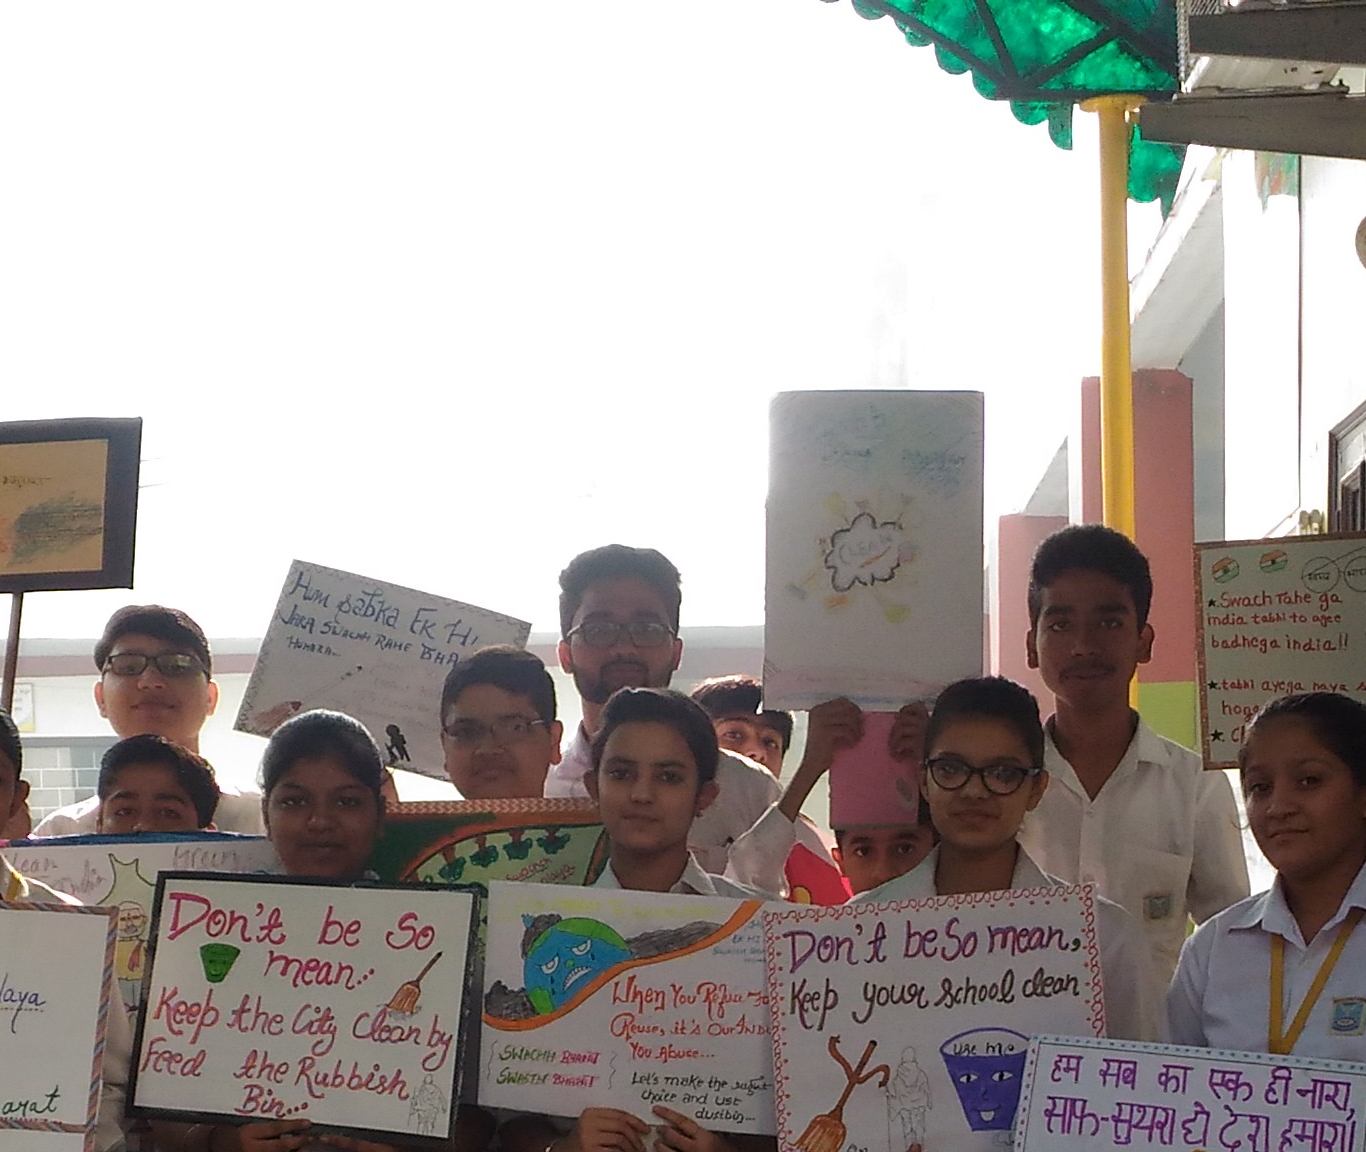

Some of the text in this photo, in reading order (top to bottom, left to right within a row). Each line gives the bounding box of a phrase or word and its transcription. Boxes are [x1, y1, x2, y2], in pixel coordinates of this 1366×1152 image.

[1289, 614, 1307, 623] to
[1319, 592, 1343, 612] ga
[419, 643, 460, 665] BHA
[167, 892, 286, 945] Don't
[318, 905, 362, 947] be
[784, 921, 887, 974] Don't
[904, 920, 937, 958] be
[612, 975, 665, 1014] When
[670, 982, 697, 1008] You
[789, 978, 839, 1031] Keep
[852, 980, 929, 1024] your
[1022, 967, 1081, 998] clean
[153, 986, 220, 1044] Keep
[227, 994, 285, 1036] the
[422, 1014, 454, 1072] by
[233, 1049, 290, 1084] the
[294, 1056, 411, 1101] Rubbish
[664, 1074, 704, 1090] make
[708, 1075, 728, 1092] the
[1051, 1054, 1084, 1083] हम
[1099, 1058, 1138, 1090] सब
[1158, 1064, 1194, 1094] का
[1208, 1068, 1253, 1101] एक
[1264, 1066, 1292, 1105] ही
